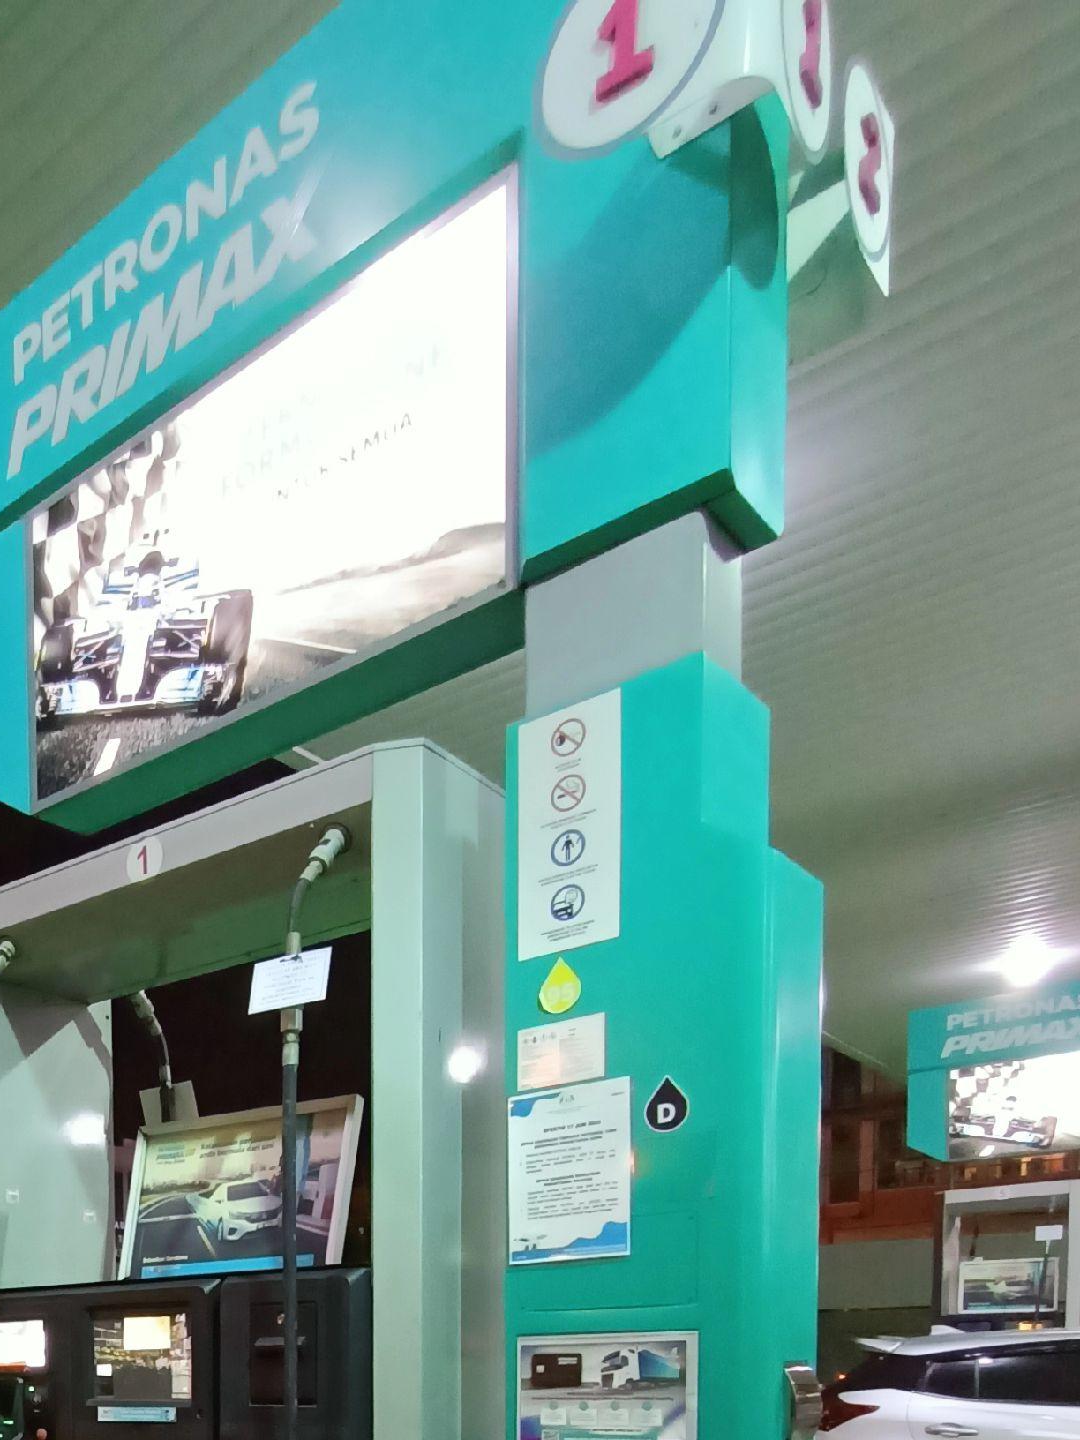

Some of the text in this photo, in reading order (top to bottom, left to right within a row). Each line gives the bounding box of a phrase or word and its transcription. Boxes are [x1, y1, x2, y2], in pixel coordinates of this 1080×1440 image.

[596, 0, 653, 104] 1
[13, 81, 319, 385] PETRONAS
[7, 196, 317, 480] PRIMAX
[137, 845, 147, 875] 1
[947, 995, 1080, 1031] PETRONA
[657, 1103, 676, 1124] D
